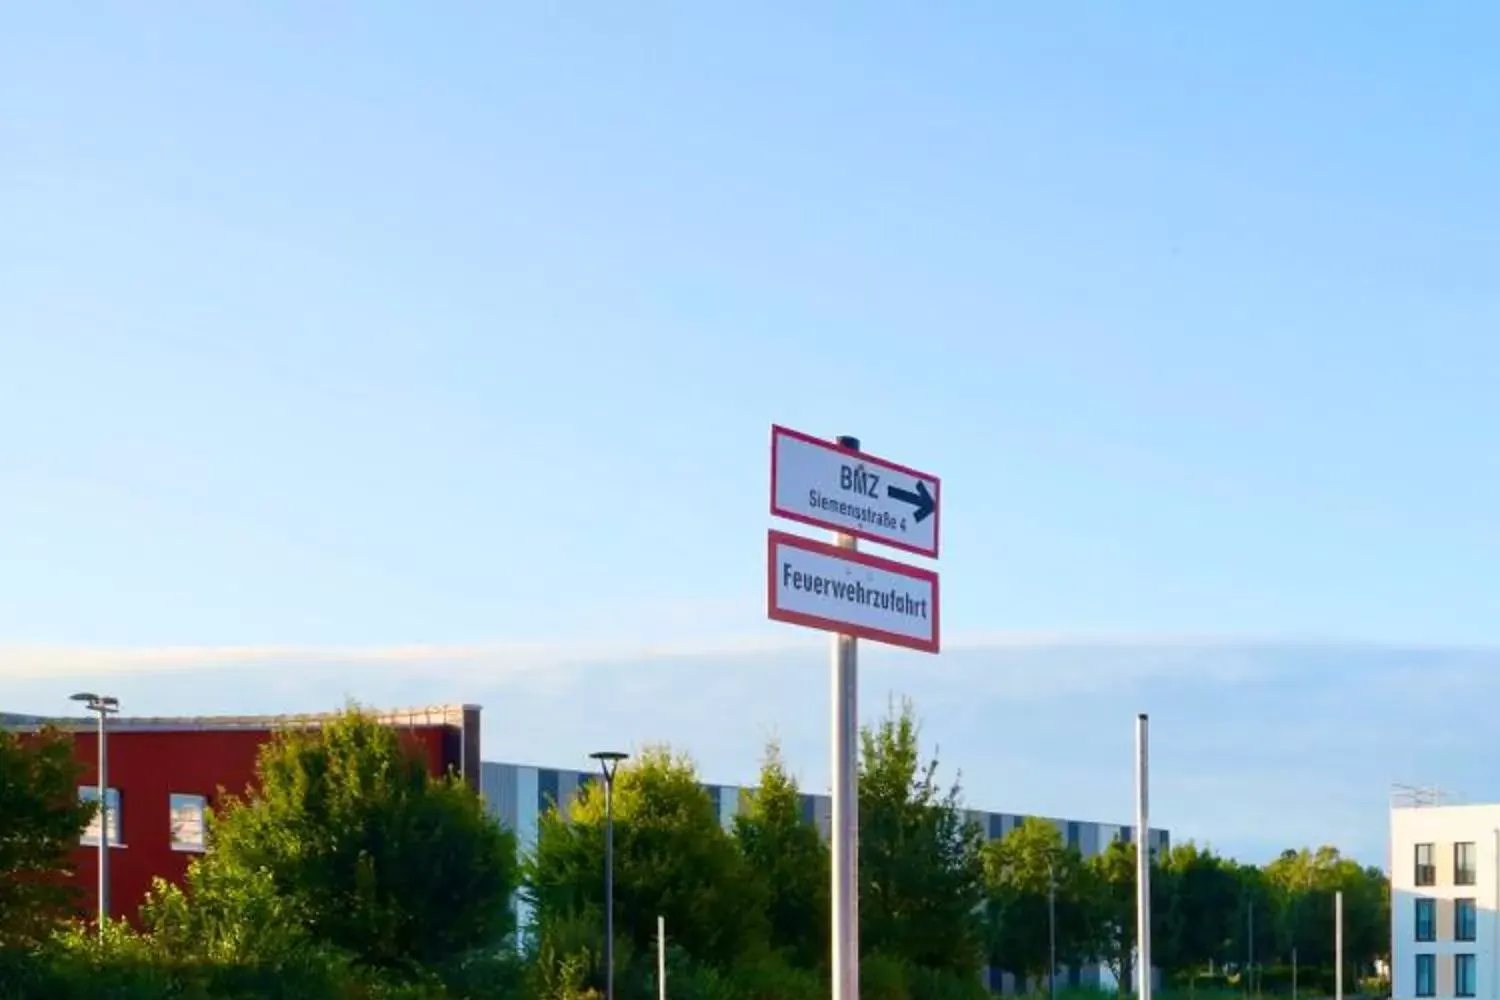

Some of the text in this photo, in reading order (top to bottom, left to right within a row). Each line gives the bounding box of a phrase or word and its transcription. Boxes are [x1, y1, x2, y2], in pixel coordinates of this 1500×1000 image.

[840, 464, 880, 499] BMZ
[809, 489, 907, 532] Siemensstraße 4
[783, 562, 928, 620] Feuerwehrzufahrt
